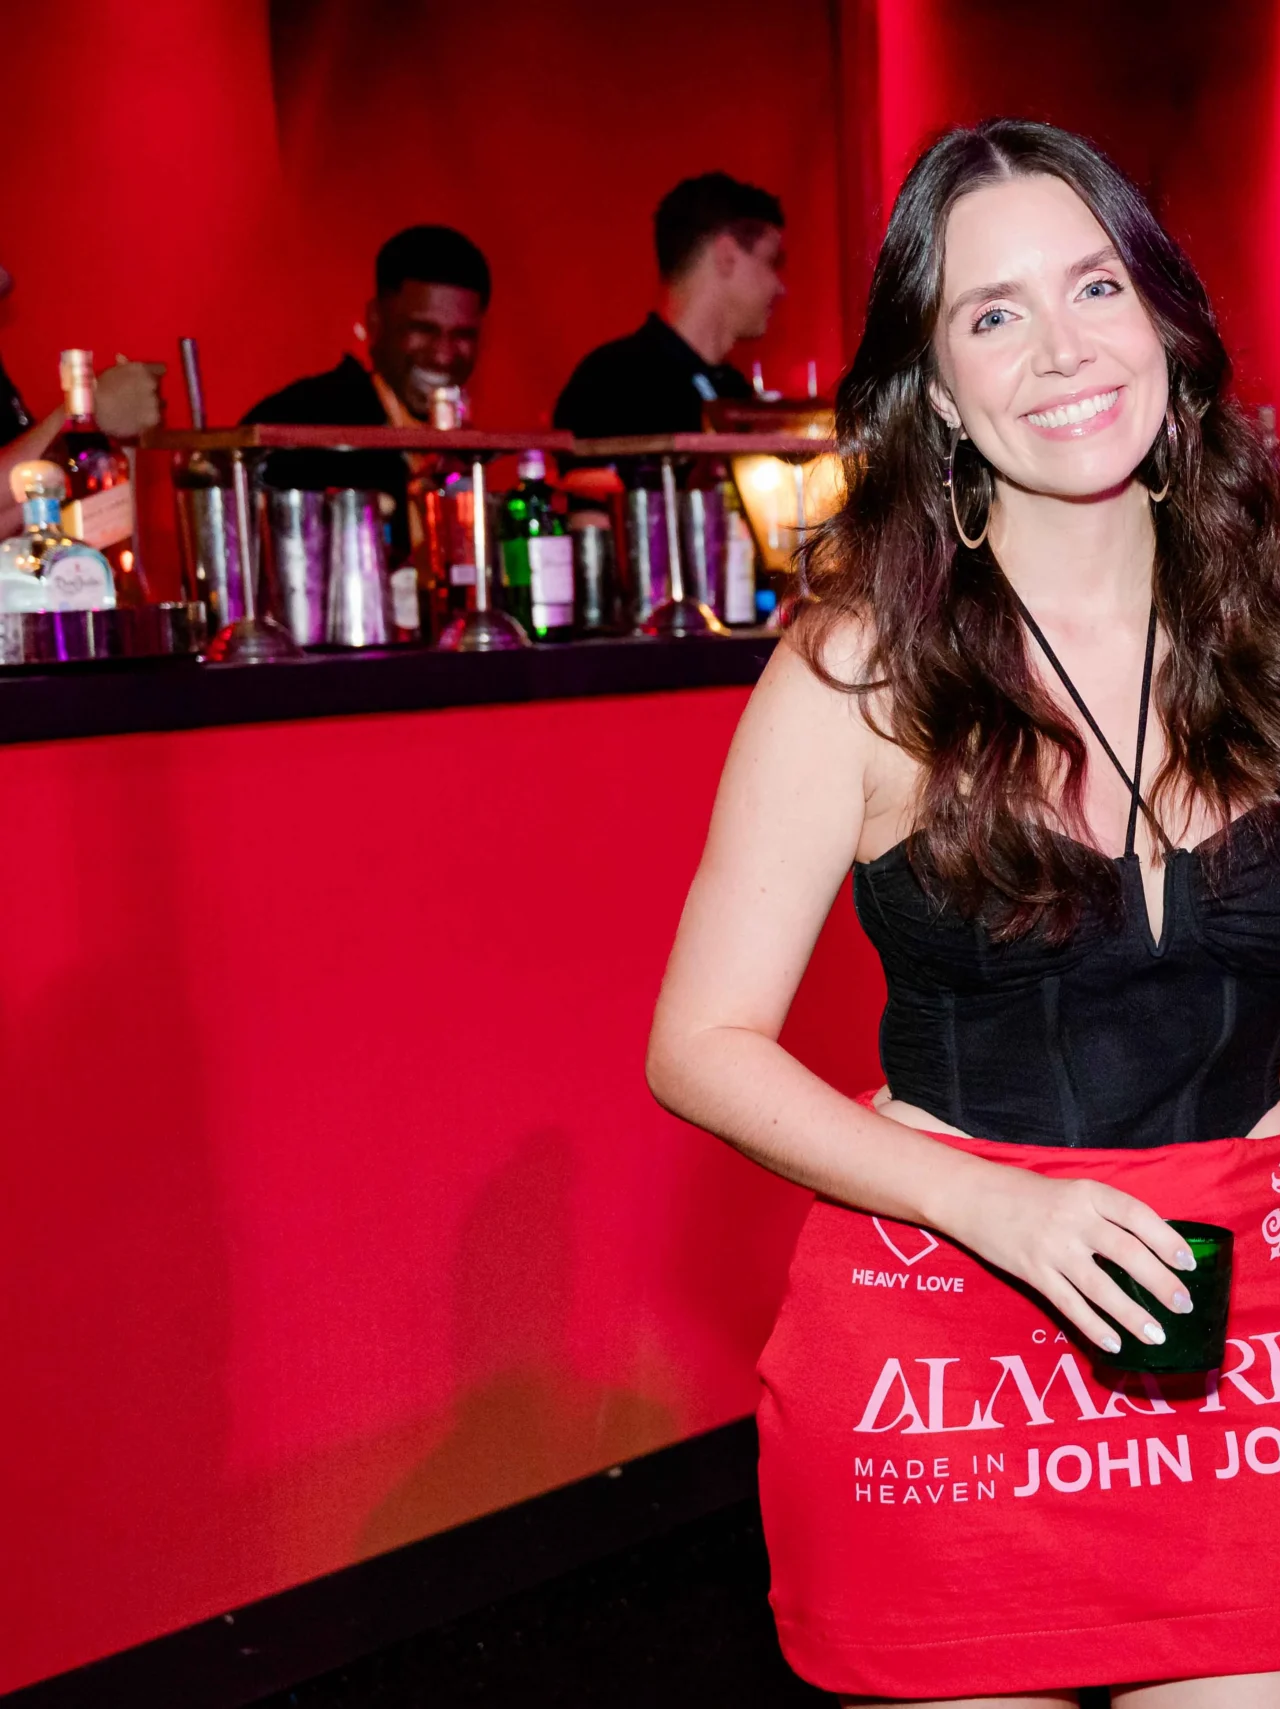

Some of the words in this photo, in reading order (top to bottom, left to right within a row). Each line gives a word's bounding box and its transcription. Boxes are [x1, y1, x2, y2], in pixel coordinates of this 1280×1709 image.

[851, 1268, 910, 1289] HEAVY
[916, 1274, 964, 1293] LOVE
[854, 1457, 950, 1479] MADE
[972, 1452, 1005, 1475] IN
[1013, 1434, 1193, 1498] JOHN
[855, 1479, 995, 1505] HEAVEN
